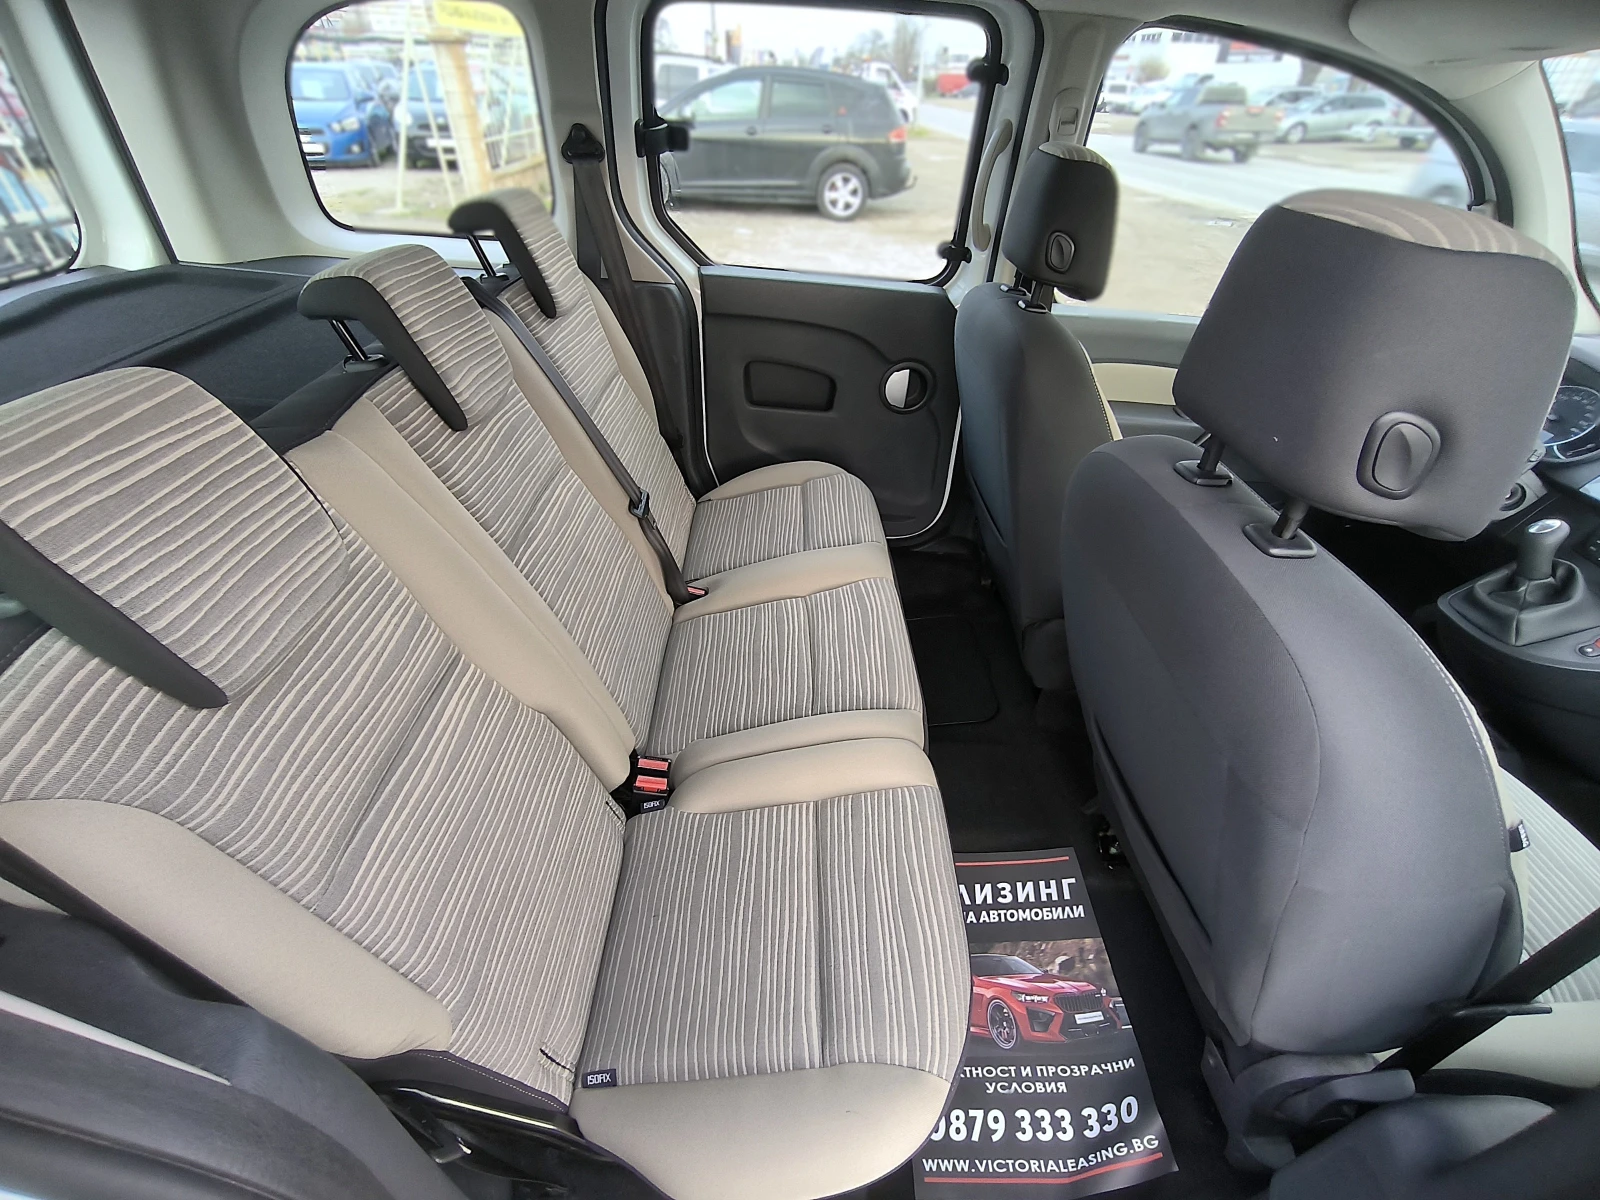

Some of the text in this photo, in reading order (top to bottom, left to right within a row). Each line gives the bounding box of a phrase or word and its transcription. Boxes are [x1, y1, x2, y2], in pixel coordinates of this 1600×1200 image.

[643, 799, 661, 810] ISOFIX
[964, 904, 1085, 924] А АВТОМОБИЛИ
[1020, 1065, 1032, 1078] И
[1036, 1057, 1136, 1077] ПРОЗРАЧНИ
[587, 1072, 612, 1086] ISOFIX
[985, 1081, 1068, 1094] УСЛОВИЯ
[1014, 1108, 1075, 1142] 333
[1080, 1095, 1139, 1139] 330
[922, 1134, 1160, 1173] WWW.VICTORIALEASING.BG
